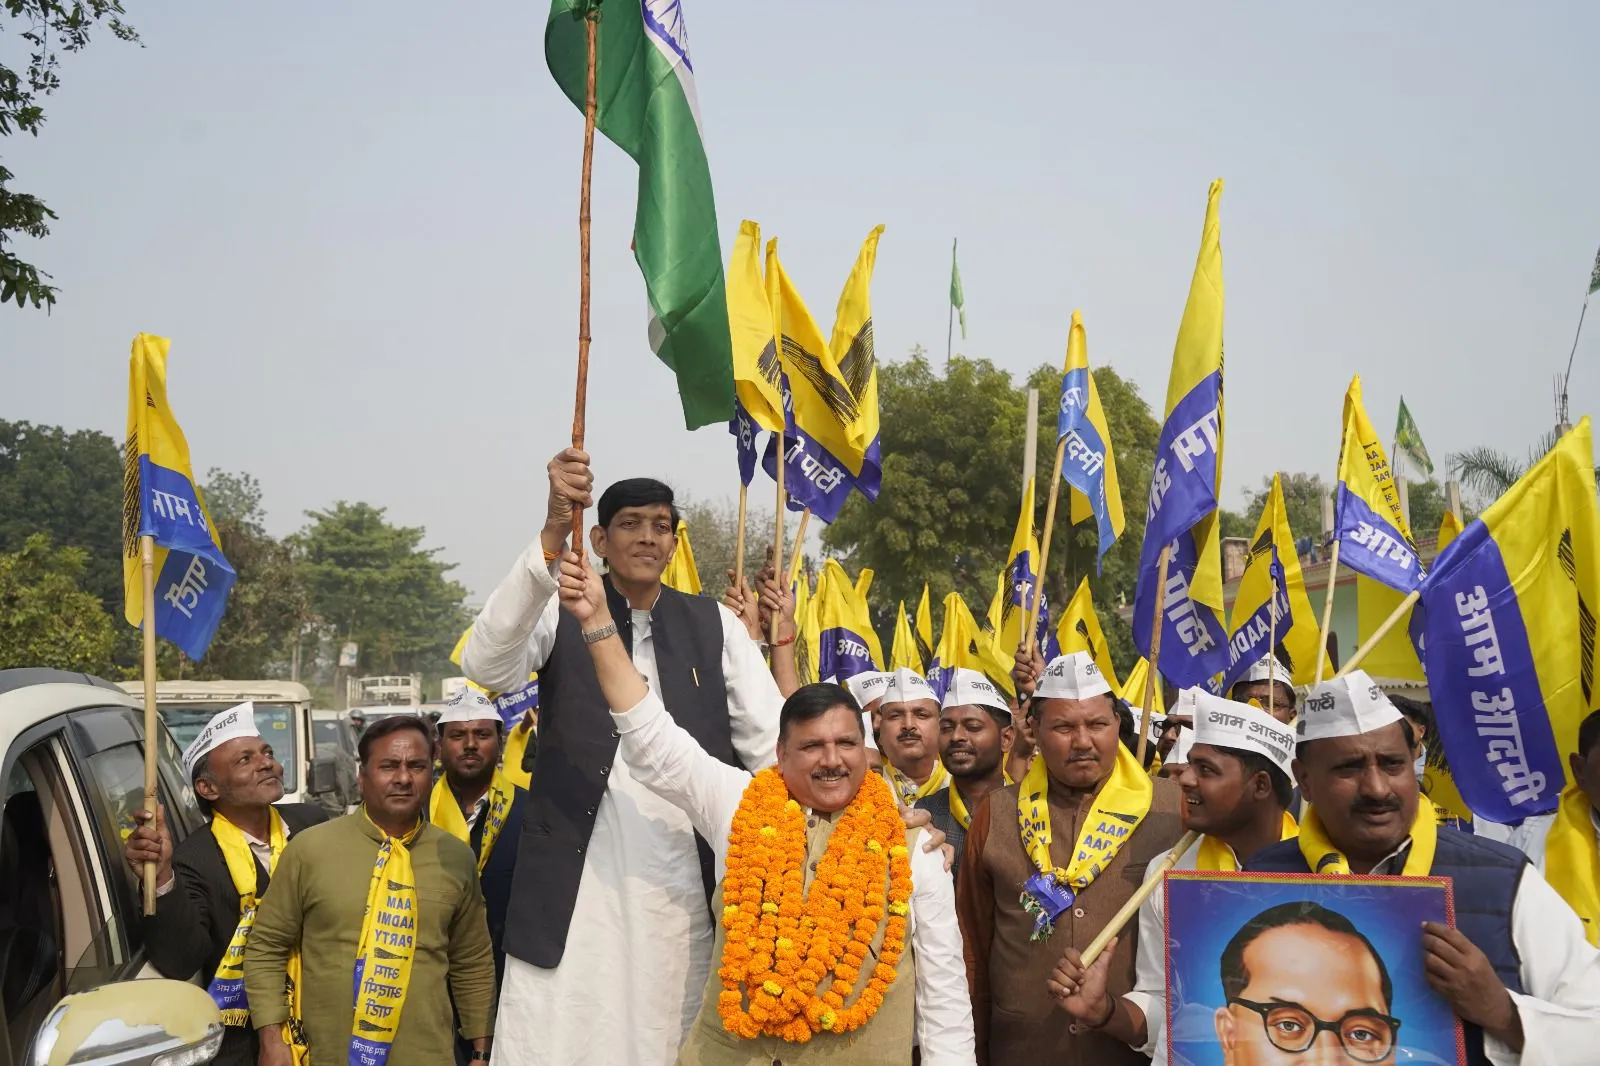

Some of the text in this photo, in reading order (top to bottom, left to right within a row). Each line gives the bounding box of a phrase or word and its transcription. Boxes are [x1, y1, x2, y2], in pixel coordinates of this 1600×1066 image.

[800, 453, 846, 494] पार्टी
[1350, 520, 1415, 570] आम
[970, 681, 994, 693] आम
[1455, 585, 1547, 807] आम आदमी
[1208, 711, 1295, 752] आम आदमी
